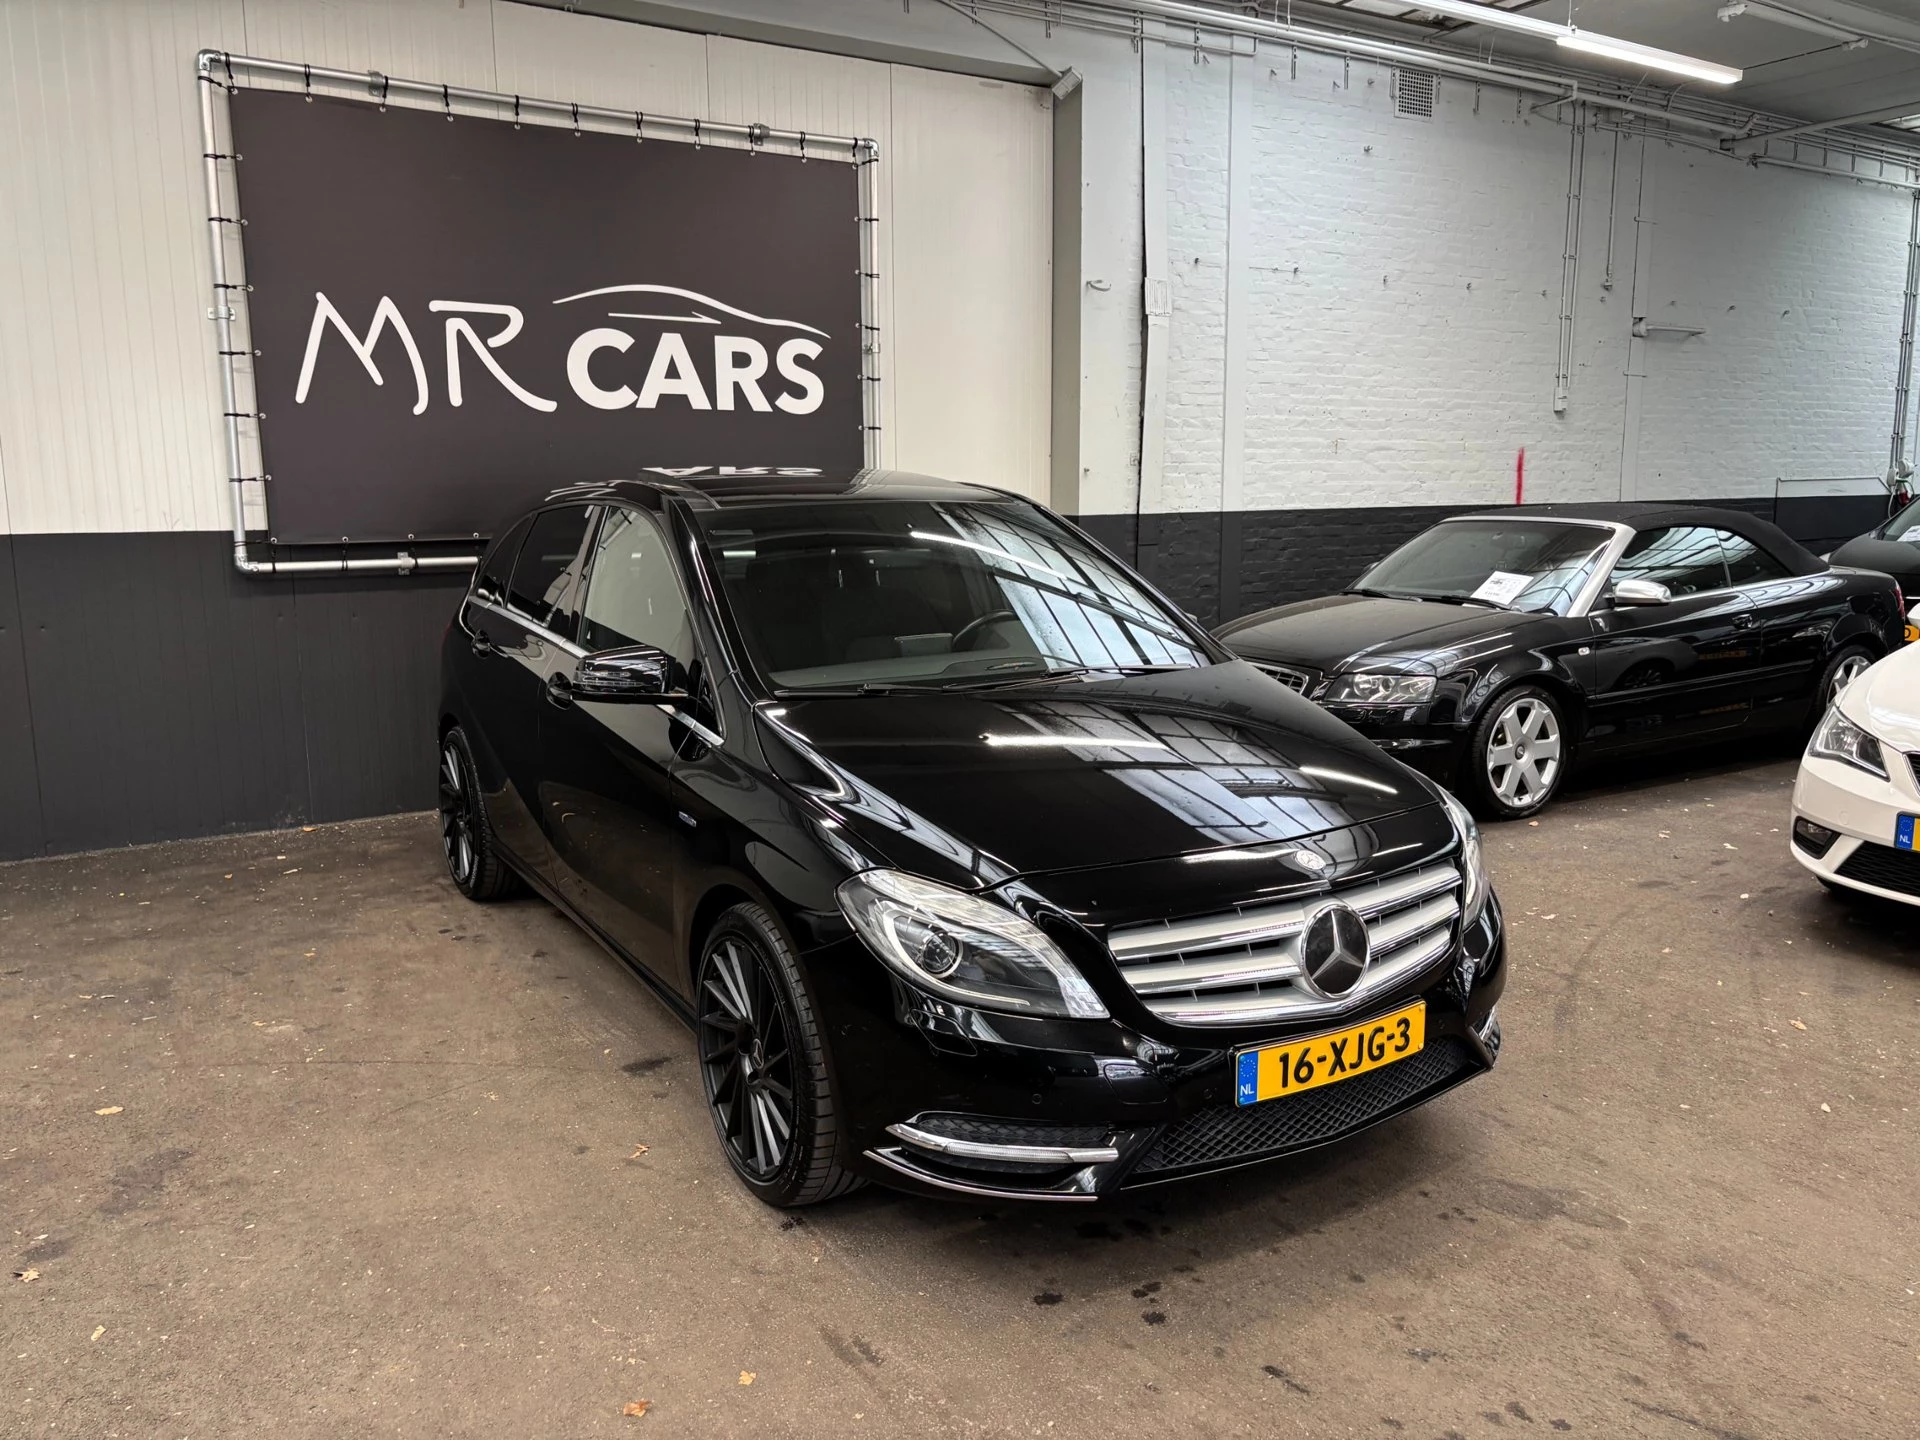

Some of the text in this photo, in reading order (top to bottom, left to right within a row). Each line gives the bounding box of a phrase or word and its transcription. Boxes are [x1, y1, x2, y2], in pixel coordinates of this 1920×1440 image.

[295, 291, 825, 416] MR CARS
[1899, 834, 1911, 844] NL
[1240, 1017, 1411, 1096] NL 16-XJG-3
